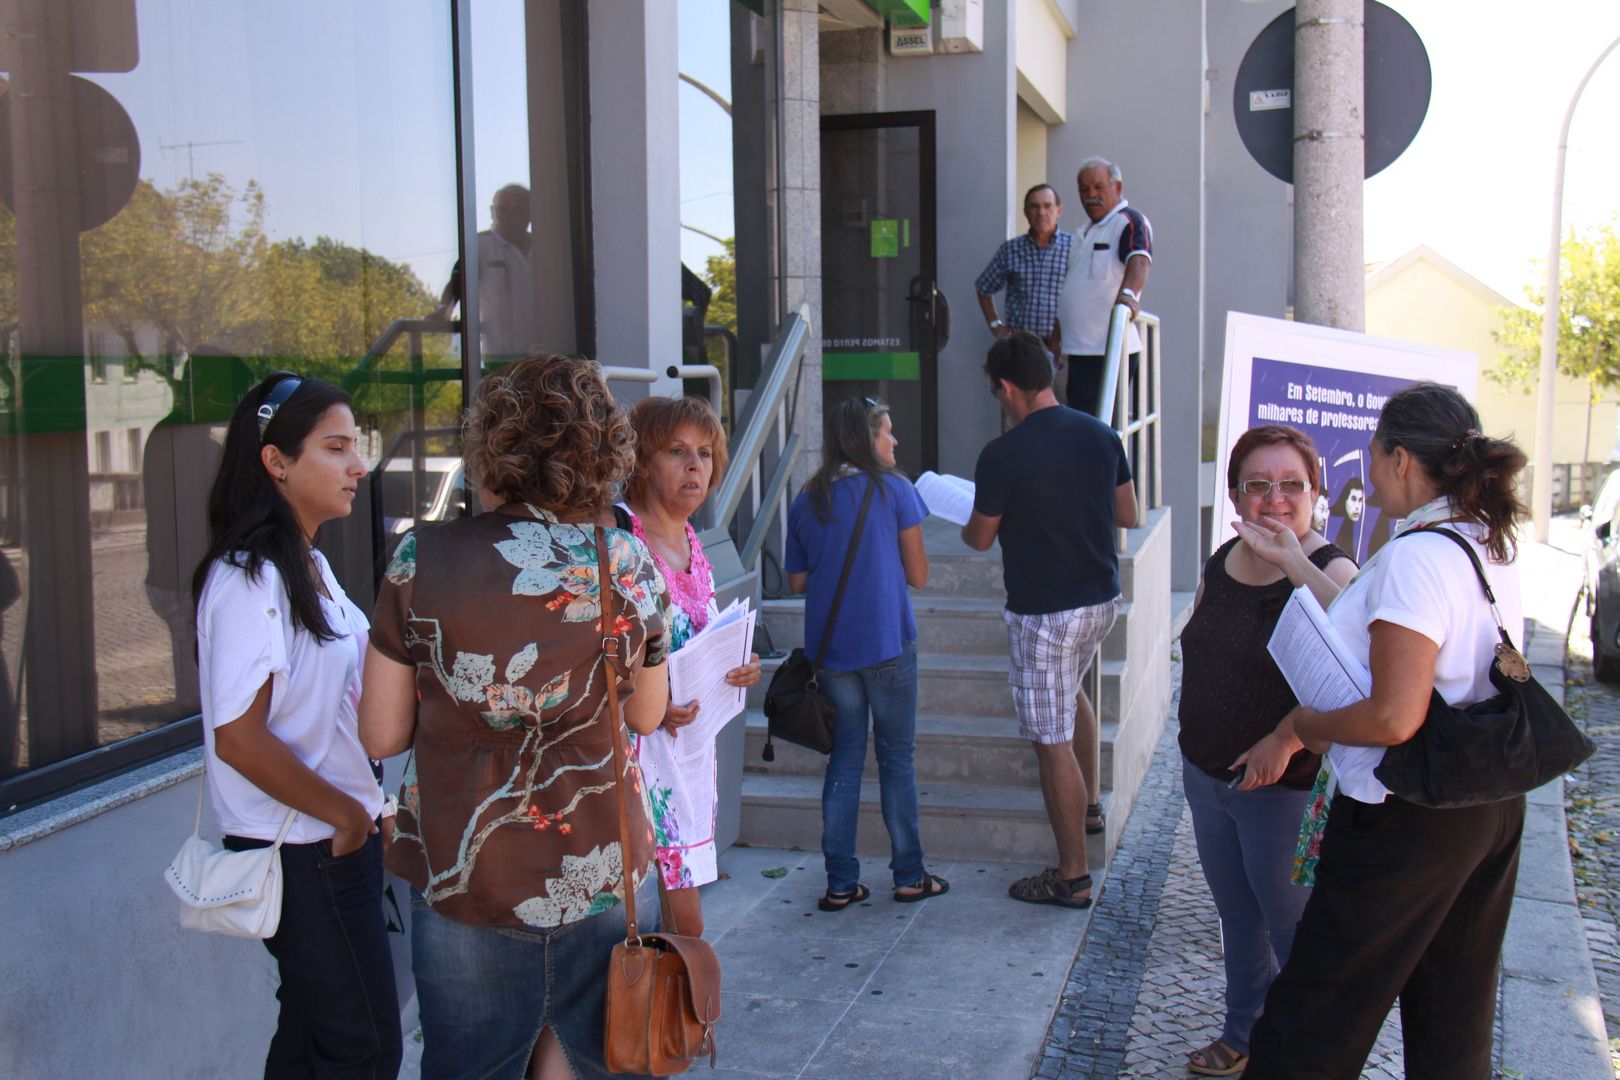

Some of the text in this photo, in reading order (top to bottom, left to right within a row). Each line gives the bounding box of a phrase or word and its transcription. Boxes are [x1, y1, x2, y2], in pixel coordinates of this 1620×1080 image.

[1287, 382, 1302, 401] Em
[1305, 384, 1355, 408] Setembro,
[1358, 393, 1364, 408] o
[1258, 403, 1303, 424] milhares
[1306, 408, 1319, 425] de
